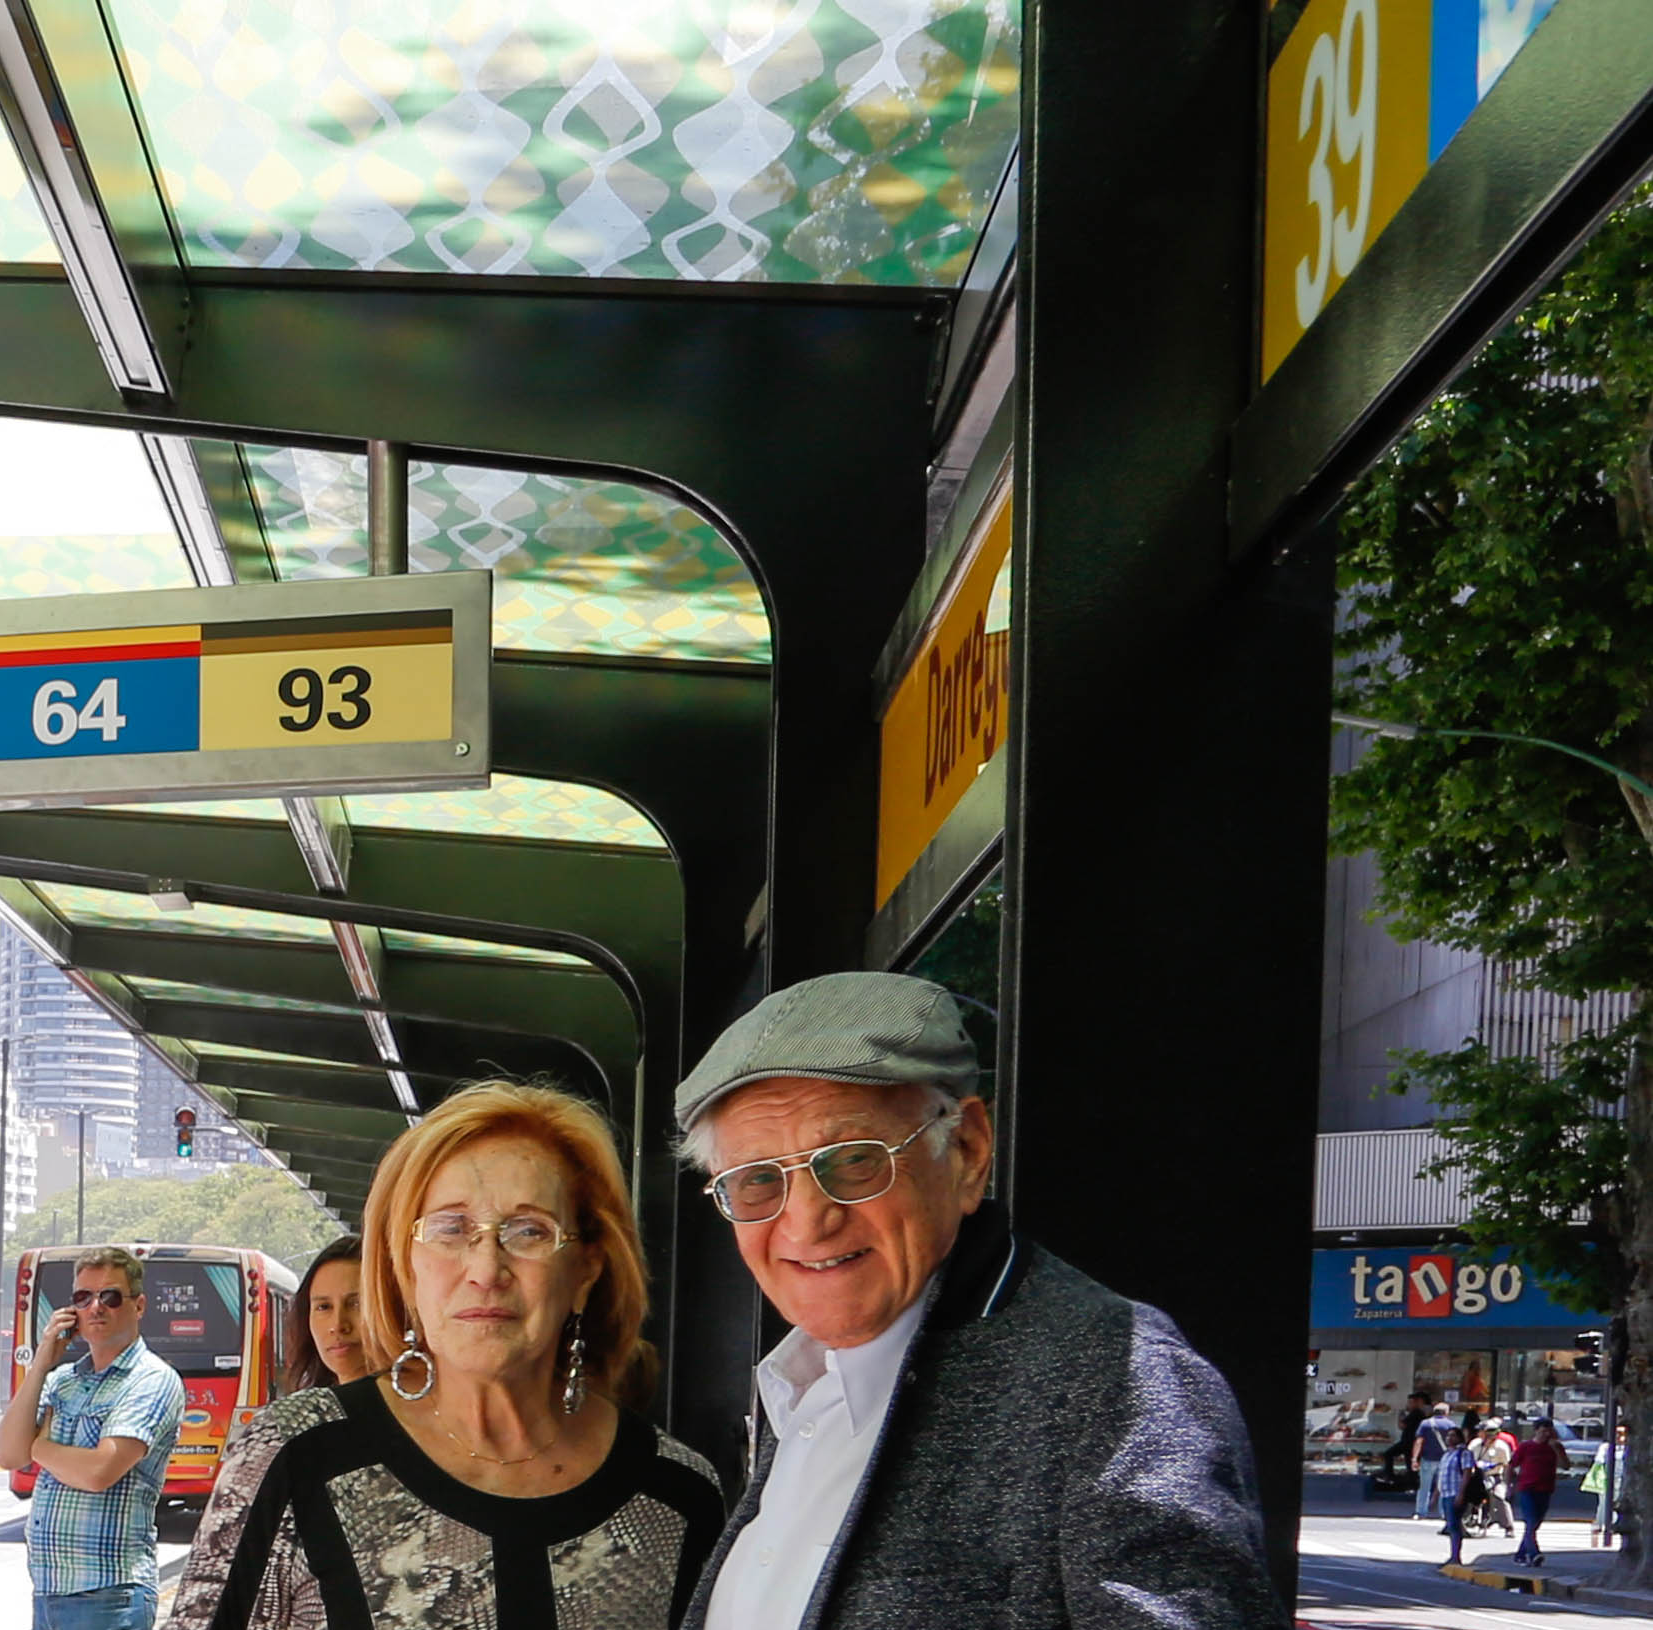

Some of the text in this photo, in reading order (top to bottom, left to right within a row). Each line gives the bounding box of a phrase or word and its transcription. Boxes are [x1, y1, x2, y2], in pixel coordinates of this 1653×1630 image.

[1295, 0, 1379, 330] 39
[31, 678, 126, 746] 64
[277, 665, 373, 732] 93
[1350, 1255, 1523, 1315] tango
[15, 1349, 30, 1361] 60
[1314, 1381, 1351, 1396] tango
